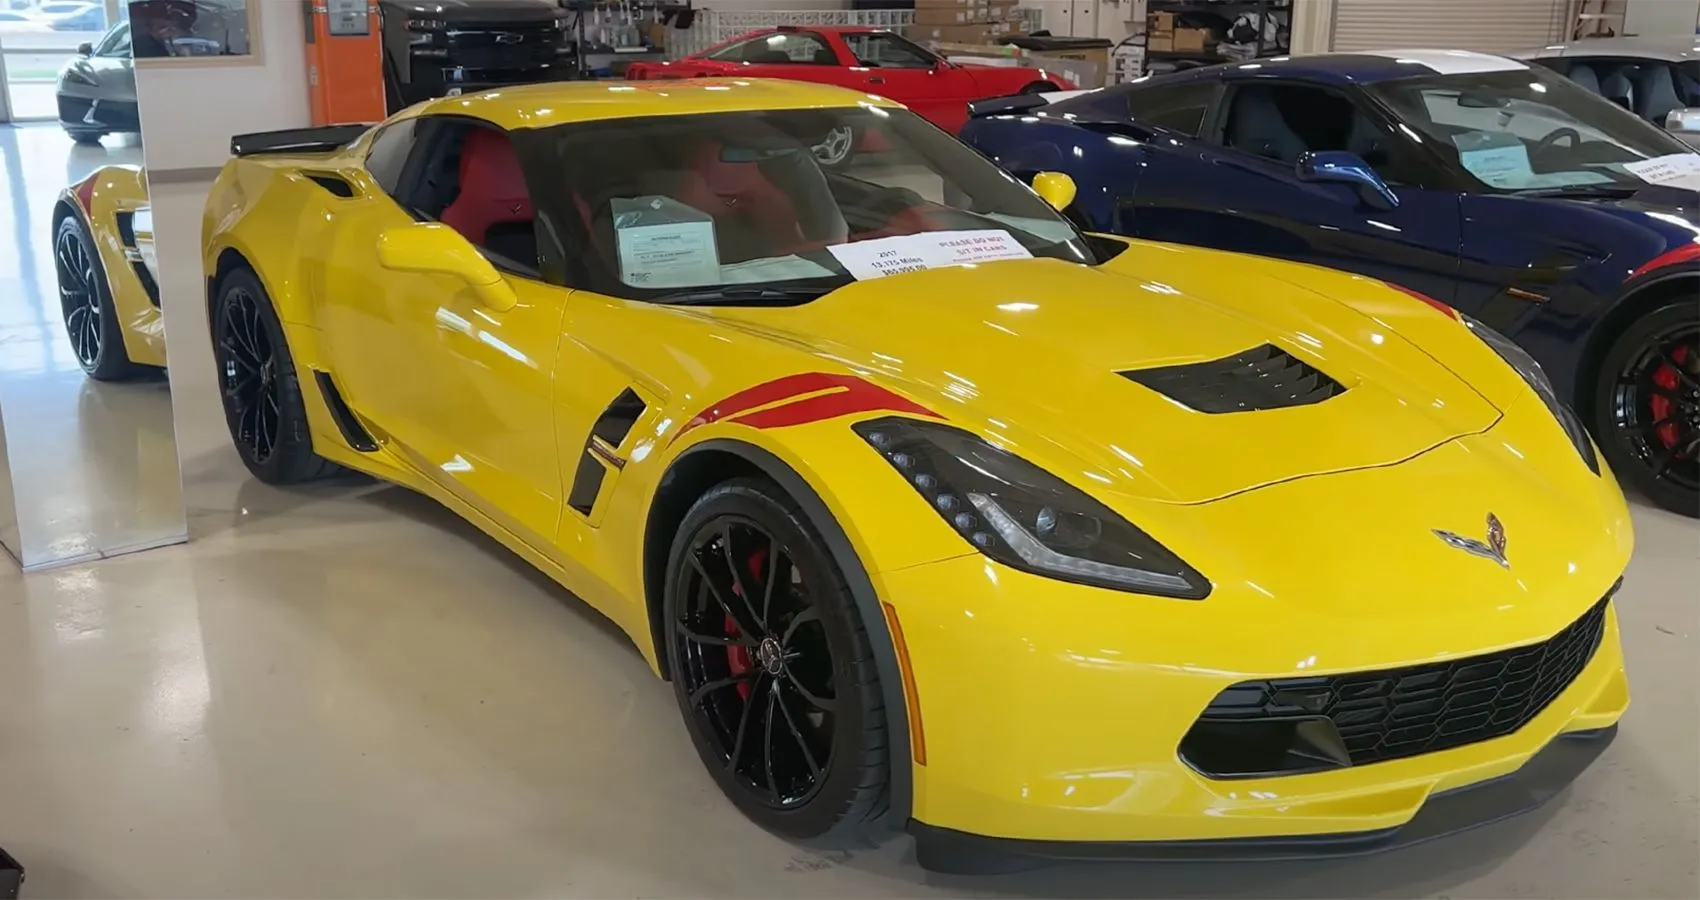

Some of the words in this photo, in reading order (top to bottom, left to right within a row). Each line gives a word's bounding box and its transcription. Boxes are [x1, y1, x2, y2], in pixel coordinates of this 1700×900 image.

[938, 238, 973, 248] PLEASE
[877, 250, 897, 258] 2017
[956, 247, 971, 256] SIT
